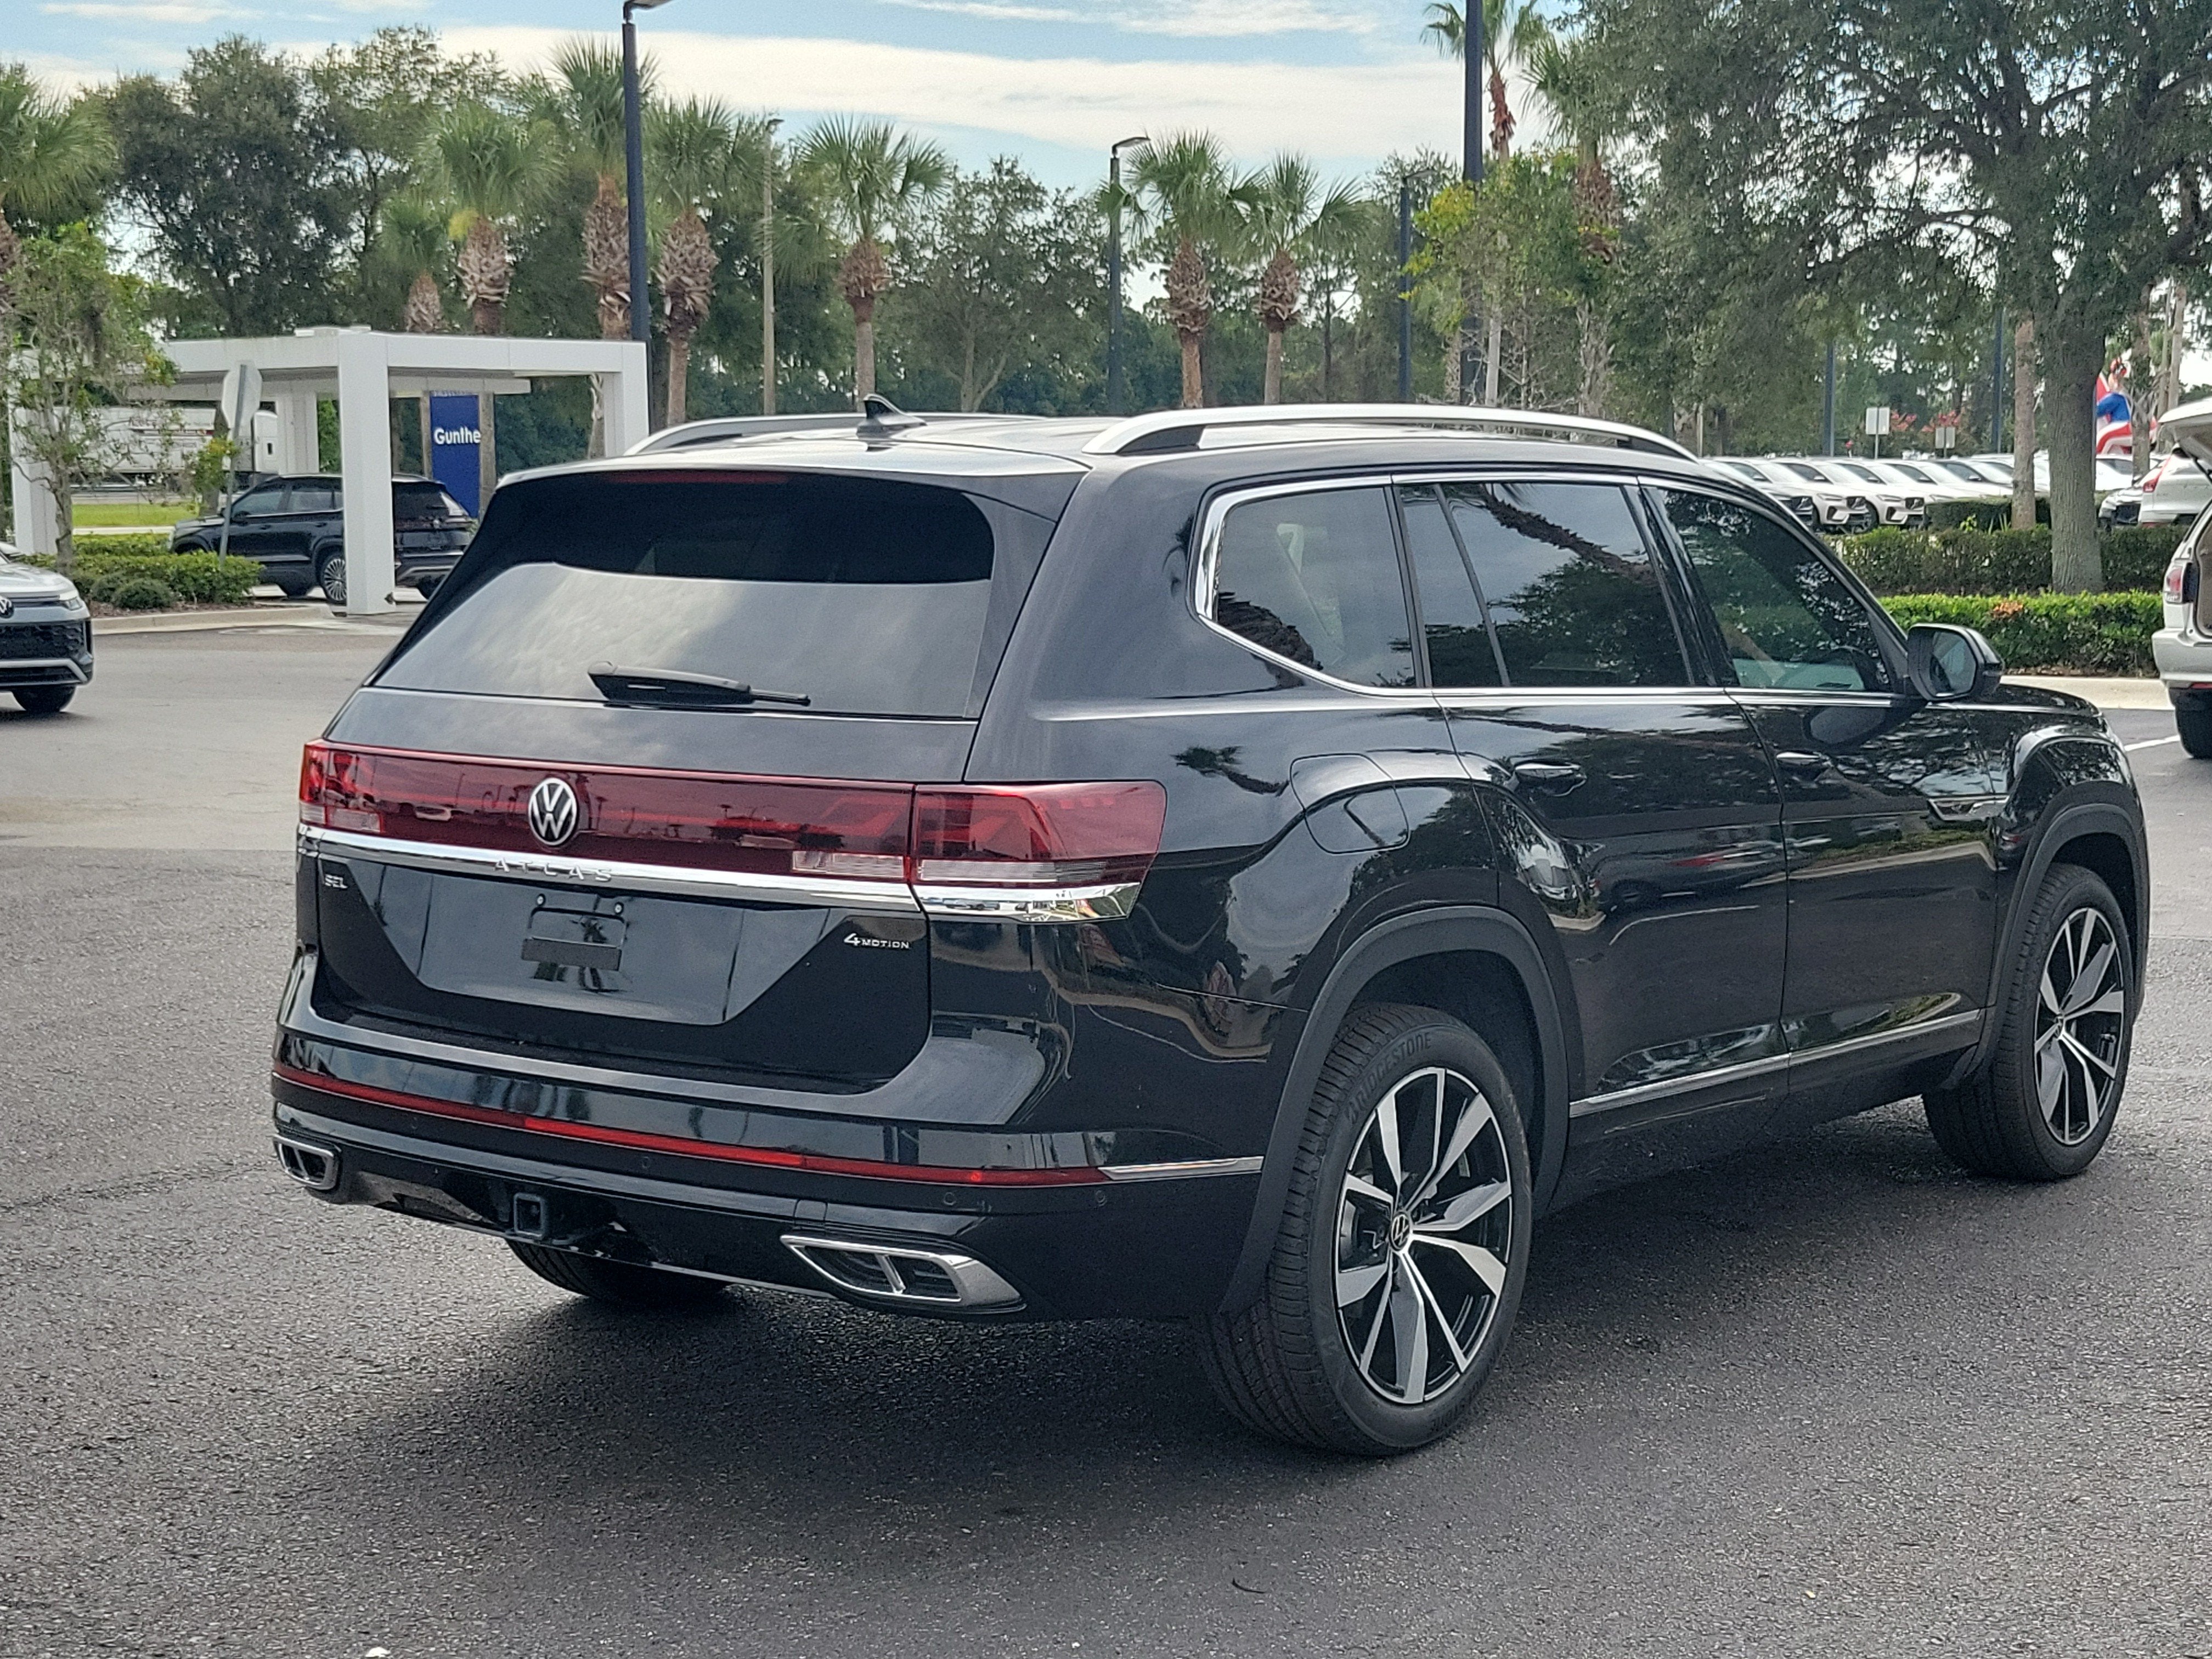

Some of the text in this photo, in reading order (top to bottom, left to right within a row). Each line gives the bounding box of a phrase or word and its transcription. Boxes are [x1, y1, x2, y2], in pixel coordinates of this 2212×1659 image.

[494, 857, 612, 882] ATLAS
[325, 874, 348, 889] SEL
[844, 933, 910, 949] 4MOTION
